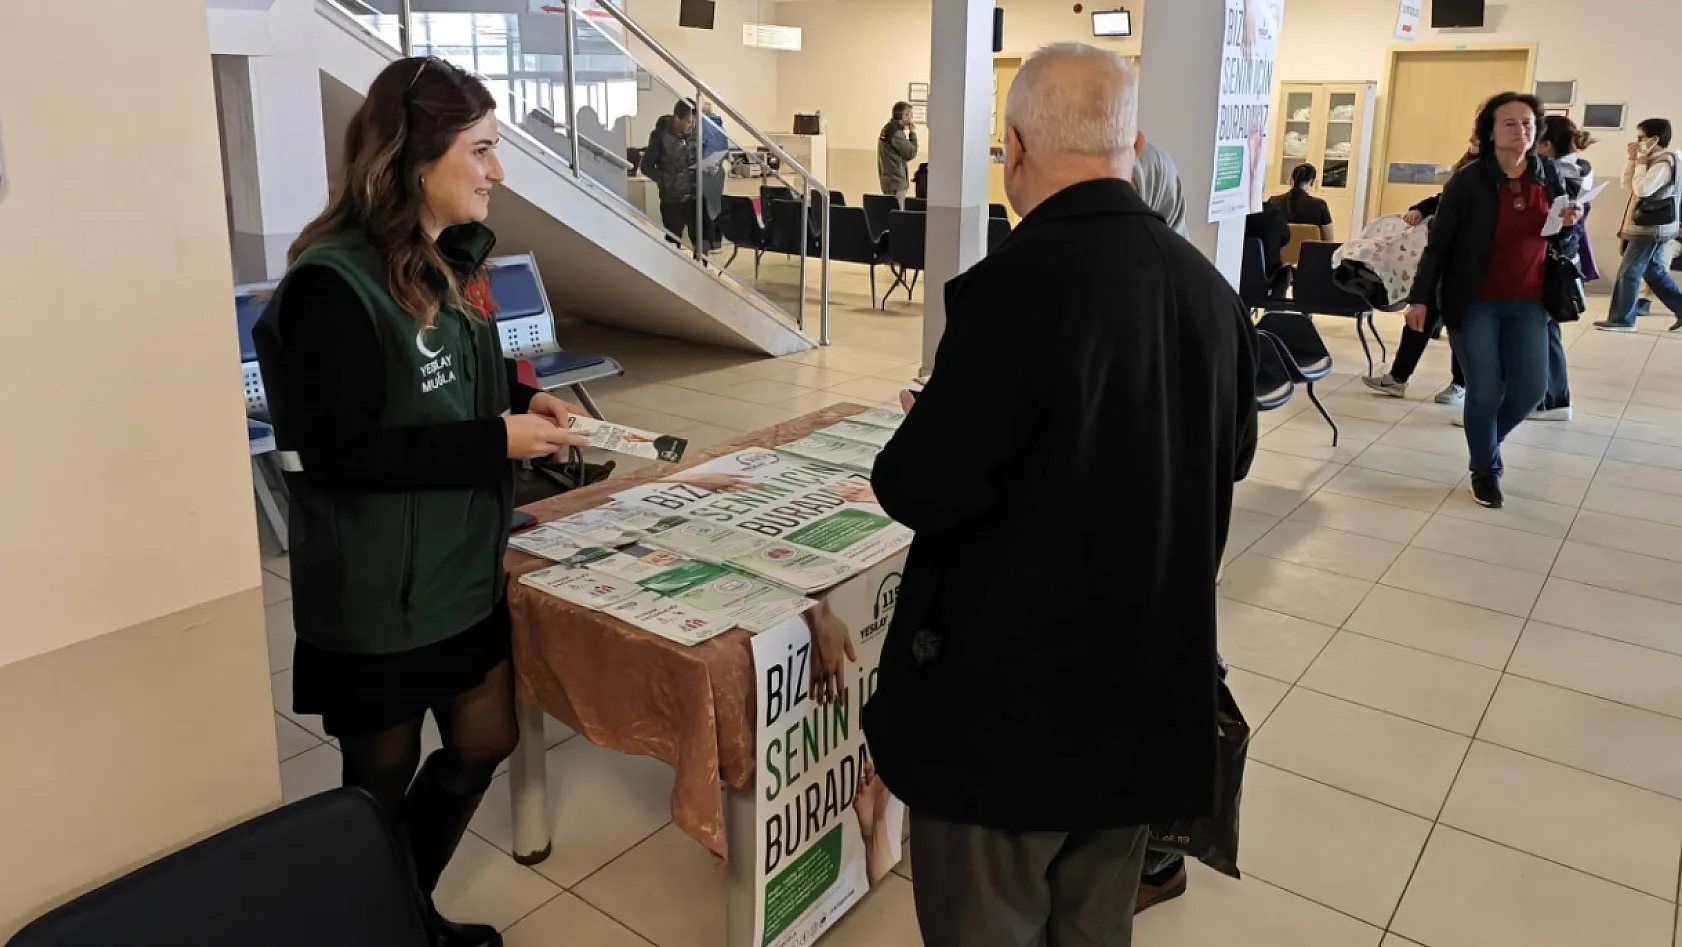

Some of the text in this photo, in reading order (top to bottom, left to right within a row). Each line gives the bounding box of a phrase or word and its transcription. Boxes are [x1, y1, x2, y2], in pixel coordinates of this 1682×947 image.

[1226, 2, 1243, 47] BİZ
[422, 371, 457, 393] MUĞLA
[765, 463, 844, 488] İÇİN
[642, 484, 711, 510] BİZ
[766, 642, 810, 728] BİZ
[765, 686, 849, 801] SENİN
